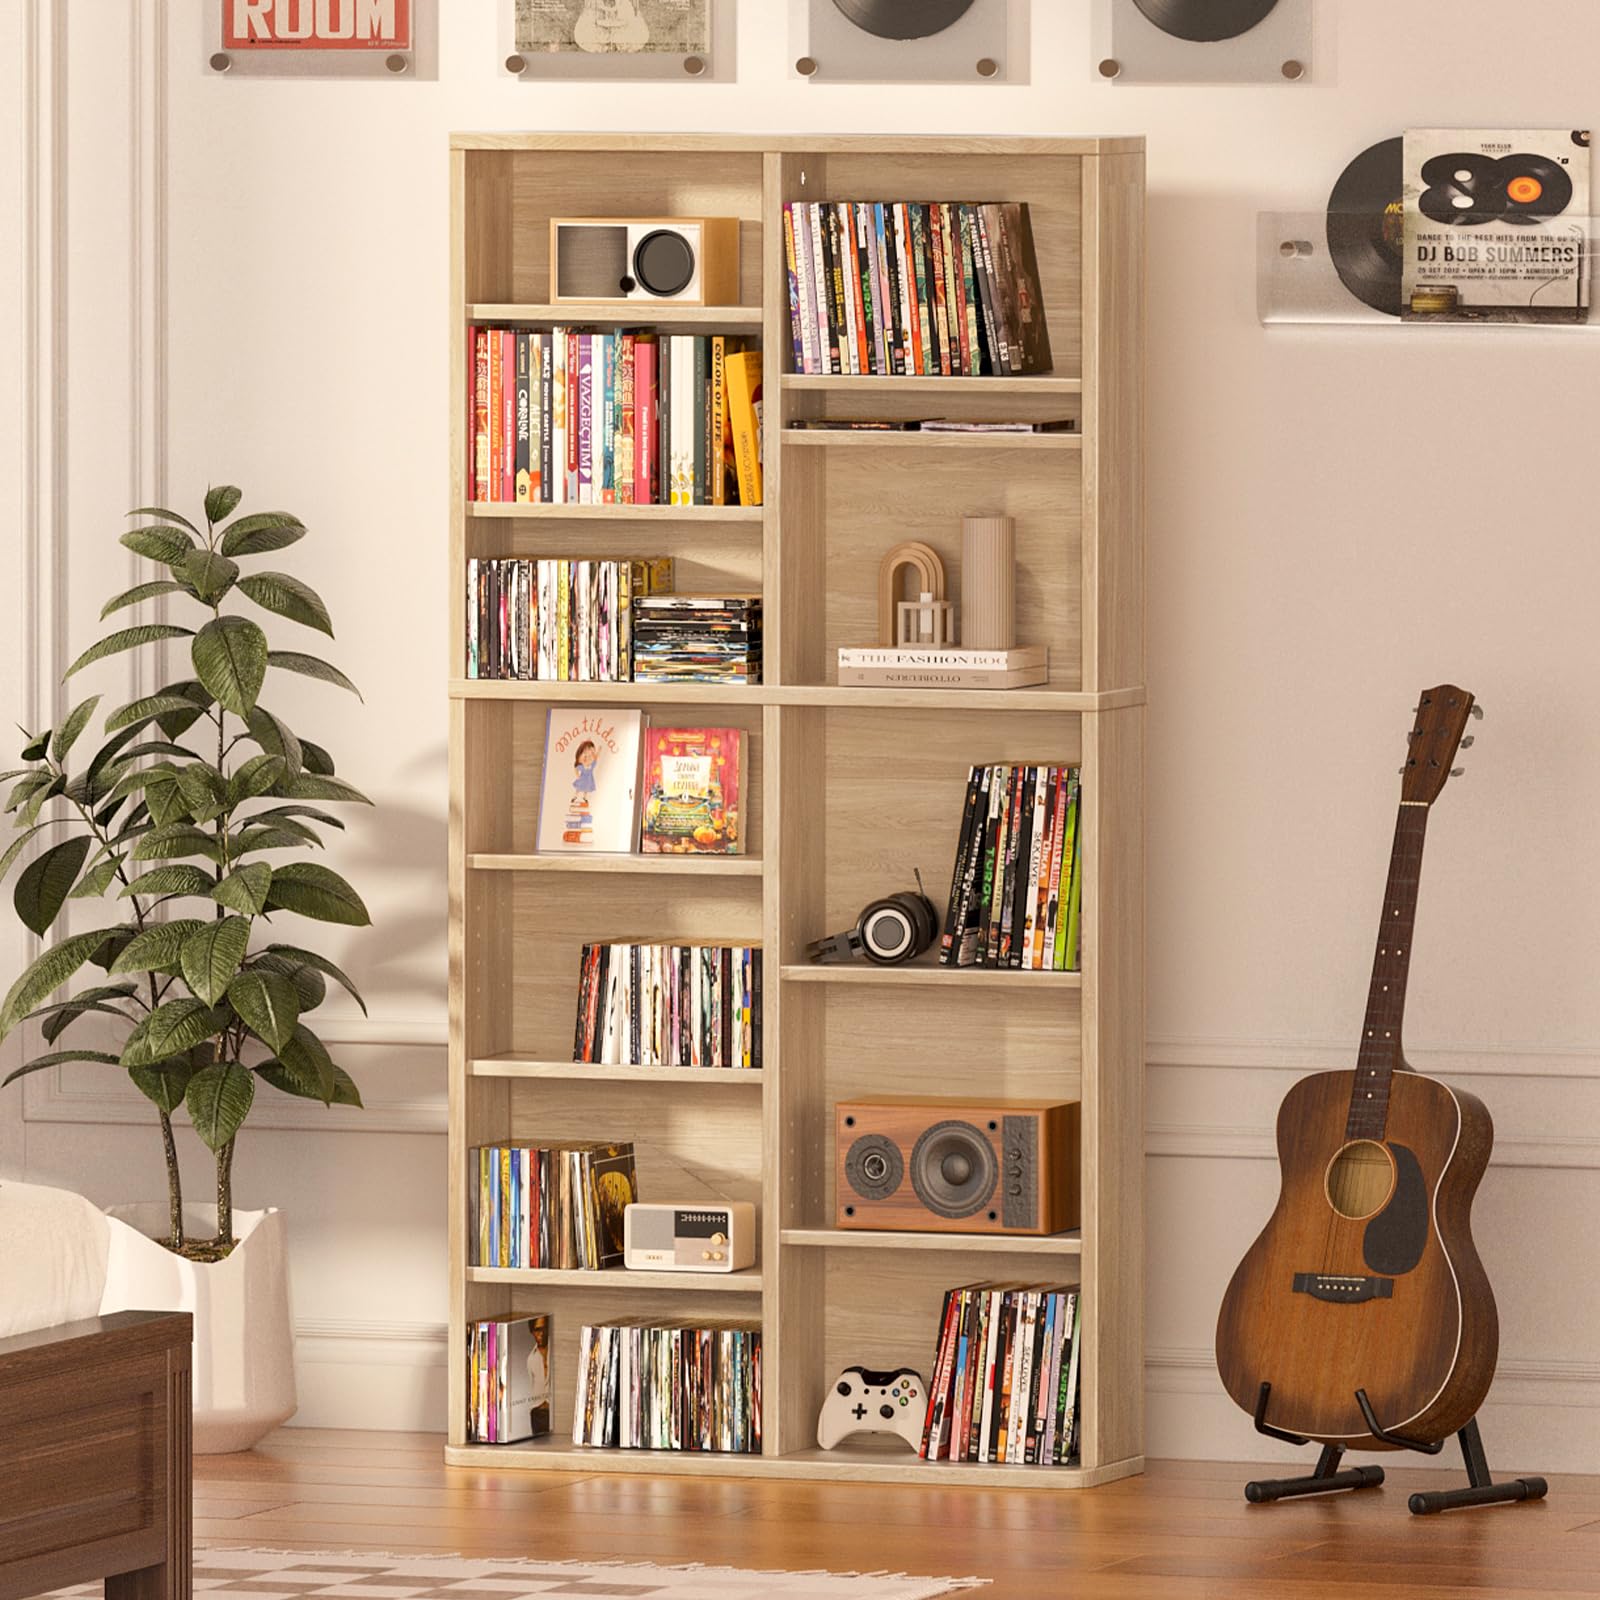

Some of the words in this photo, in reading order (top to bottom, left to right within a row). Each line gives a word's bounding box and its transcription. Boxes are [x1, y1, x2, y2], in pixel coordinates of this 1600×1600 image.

[1417, 246, 1437, 262] DJ
[1444, 246, 1479, 262] BOB
[1485, 247, 1574, 263] SUMMERS
[715, 391, 722, 408] OF
[897, 656, 968, 664] FASHION
[555, 715, 620, 754] Matilda
